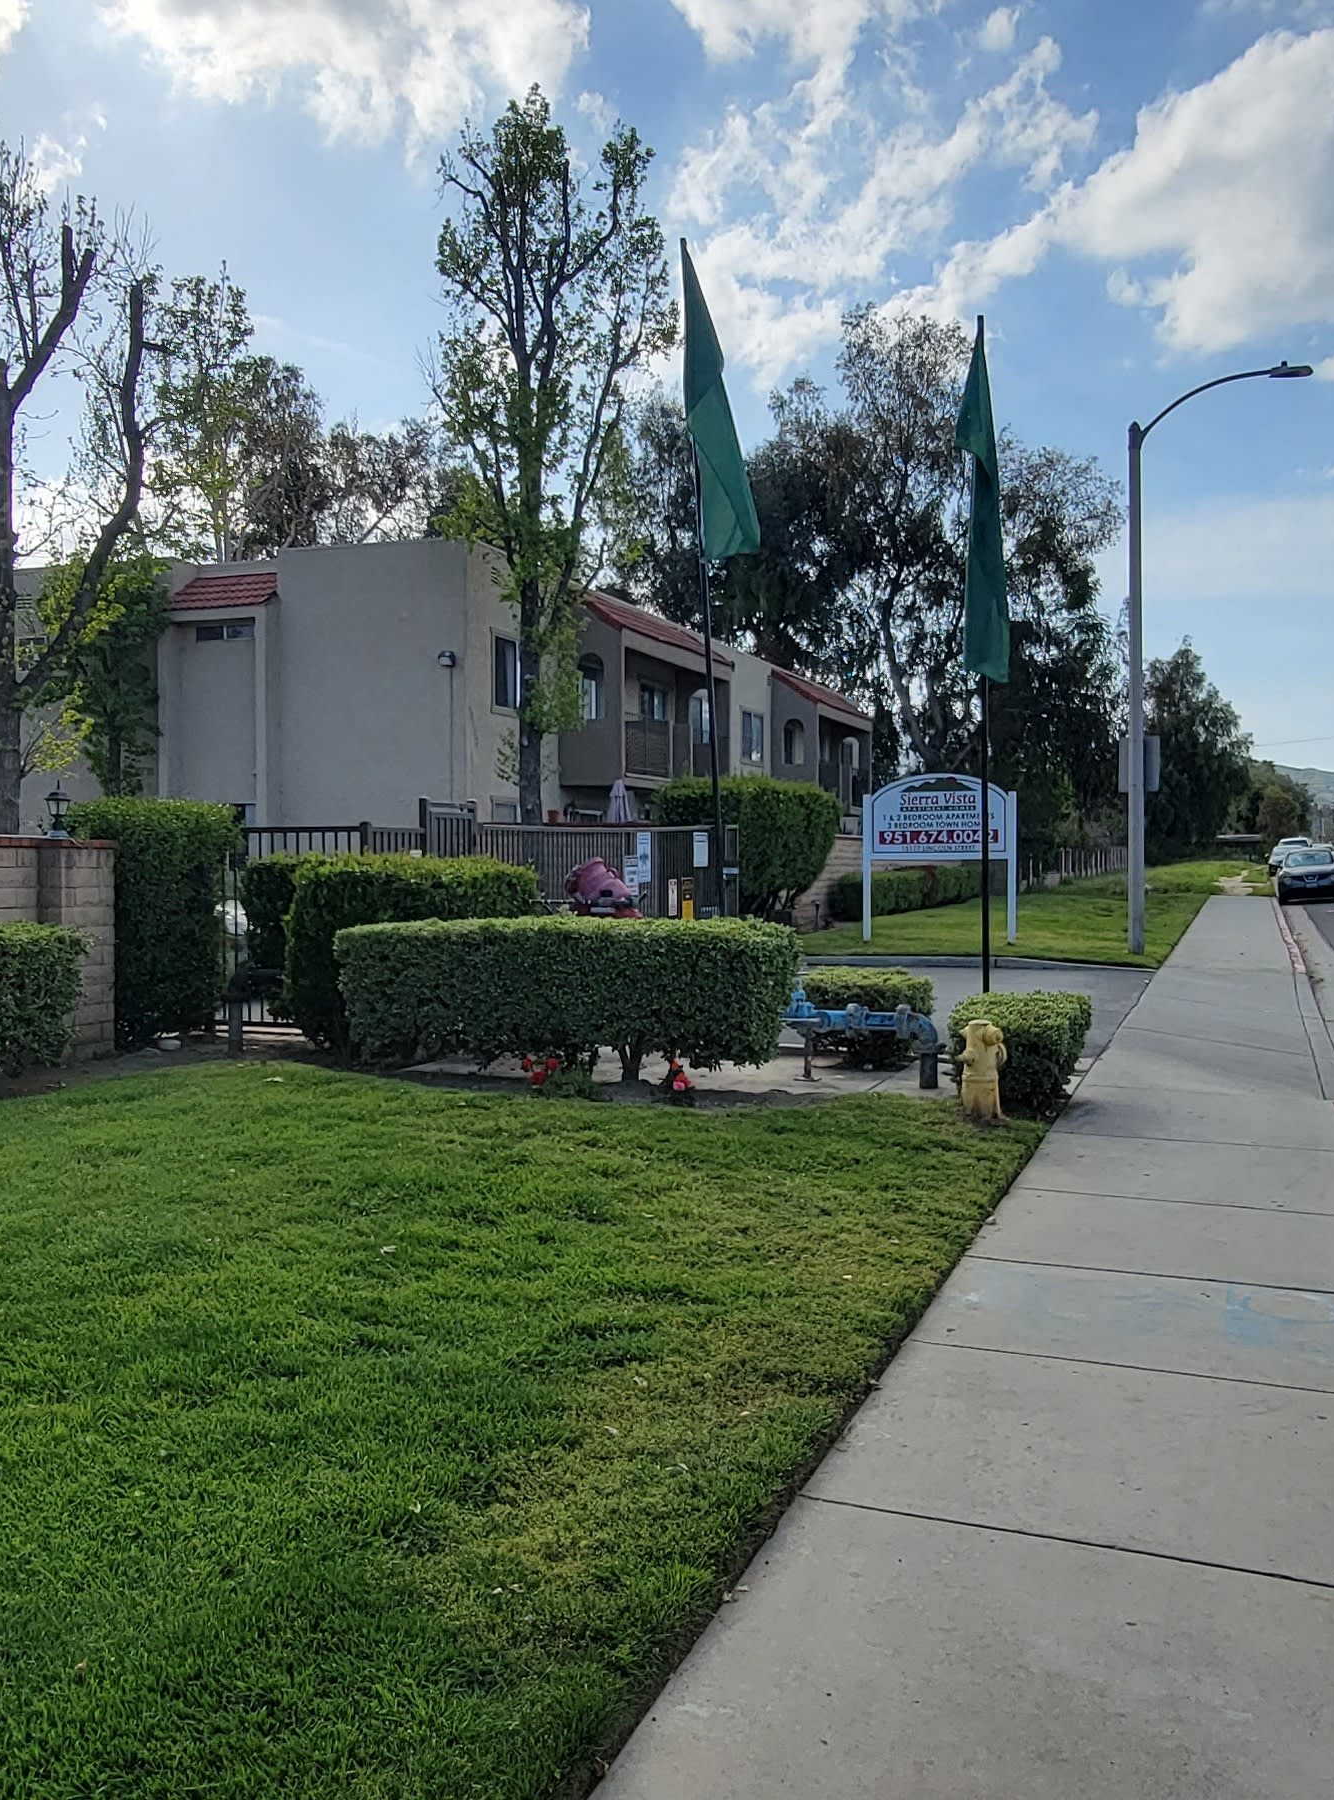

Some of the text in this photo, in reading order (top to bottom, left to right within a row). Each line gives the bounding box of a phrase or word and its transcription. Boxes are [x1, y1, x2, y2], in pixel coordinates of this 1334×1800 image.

[899, 792, 976, 806] Sierra Vista
[945, 812, 995, 820] APARTMES
[883, 830, 994, 844] 951.674.0042
